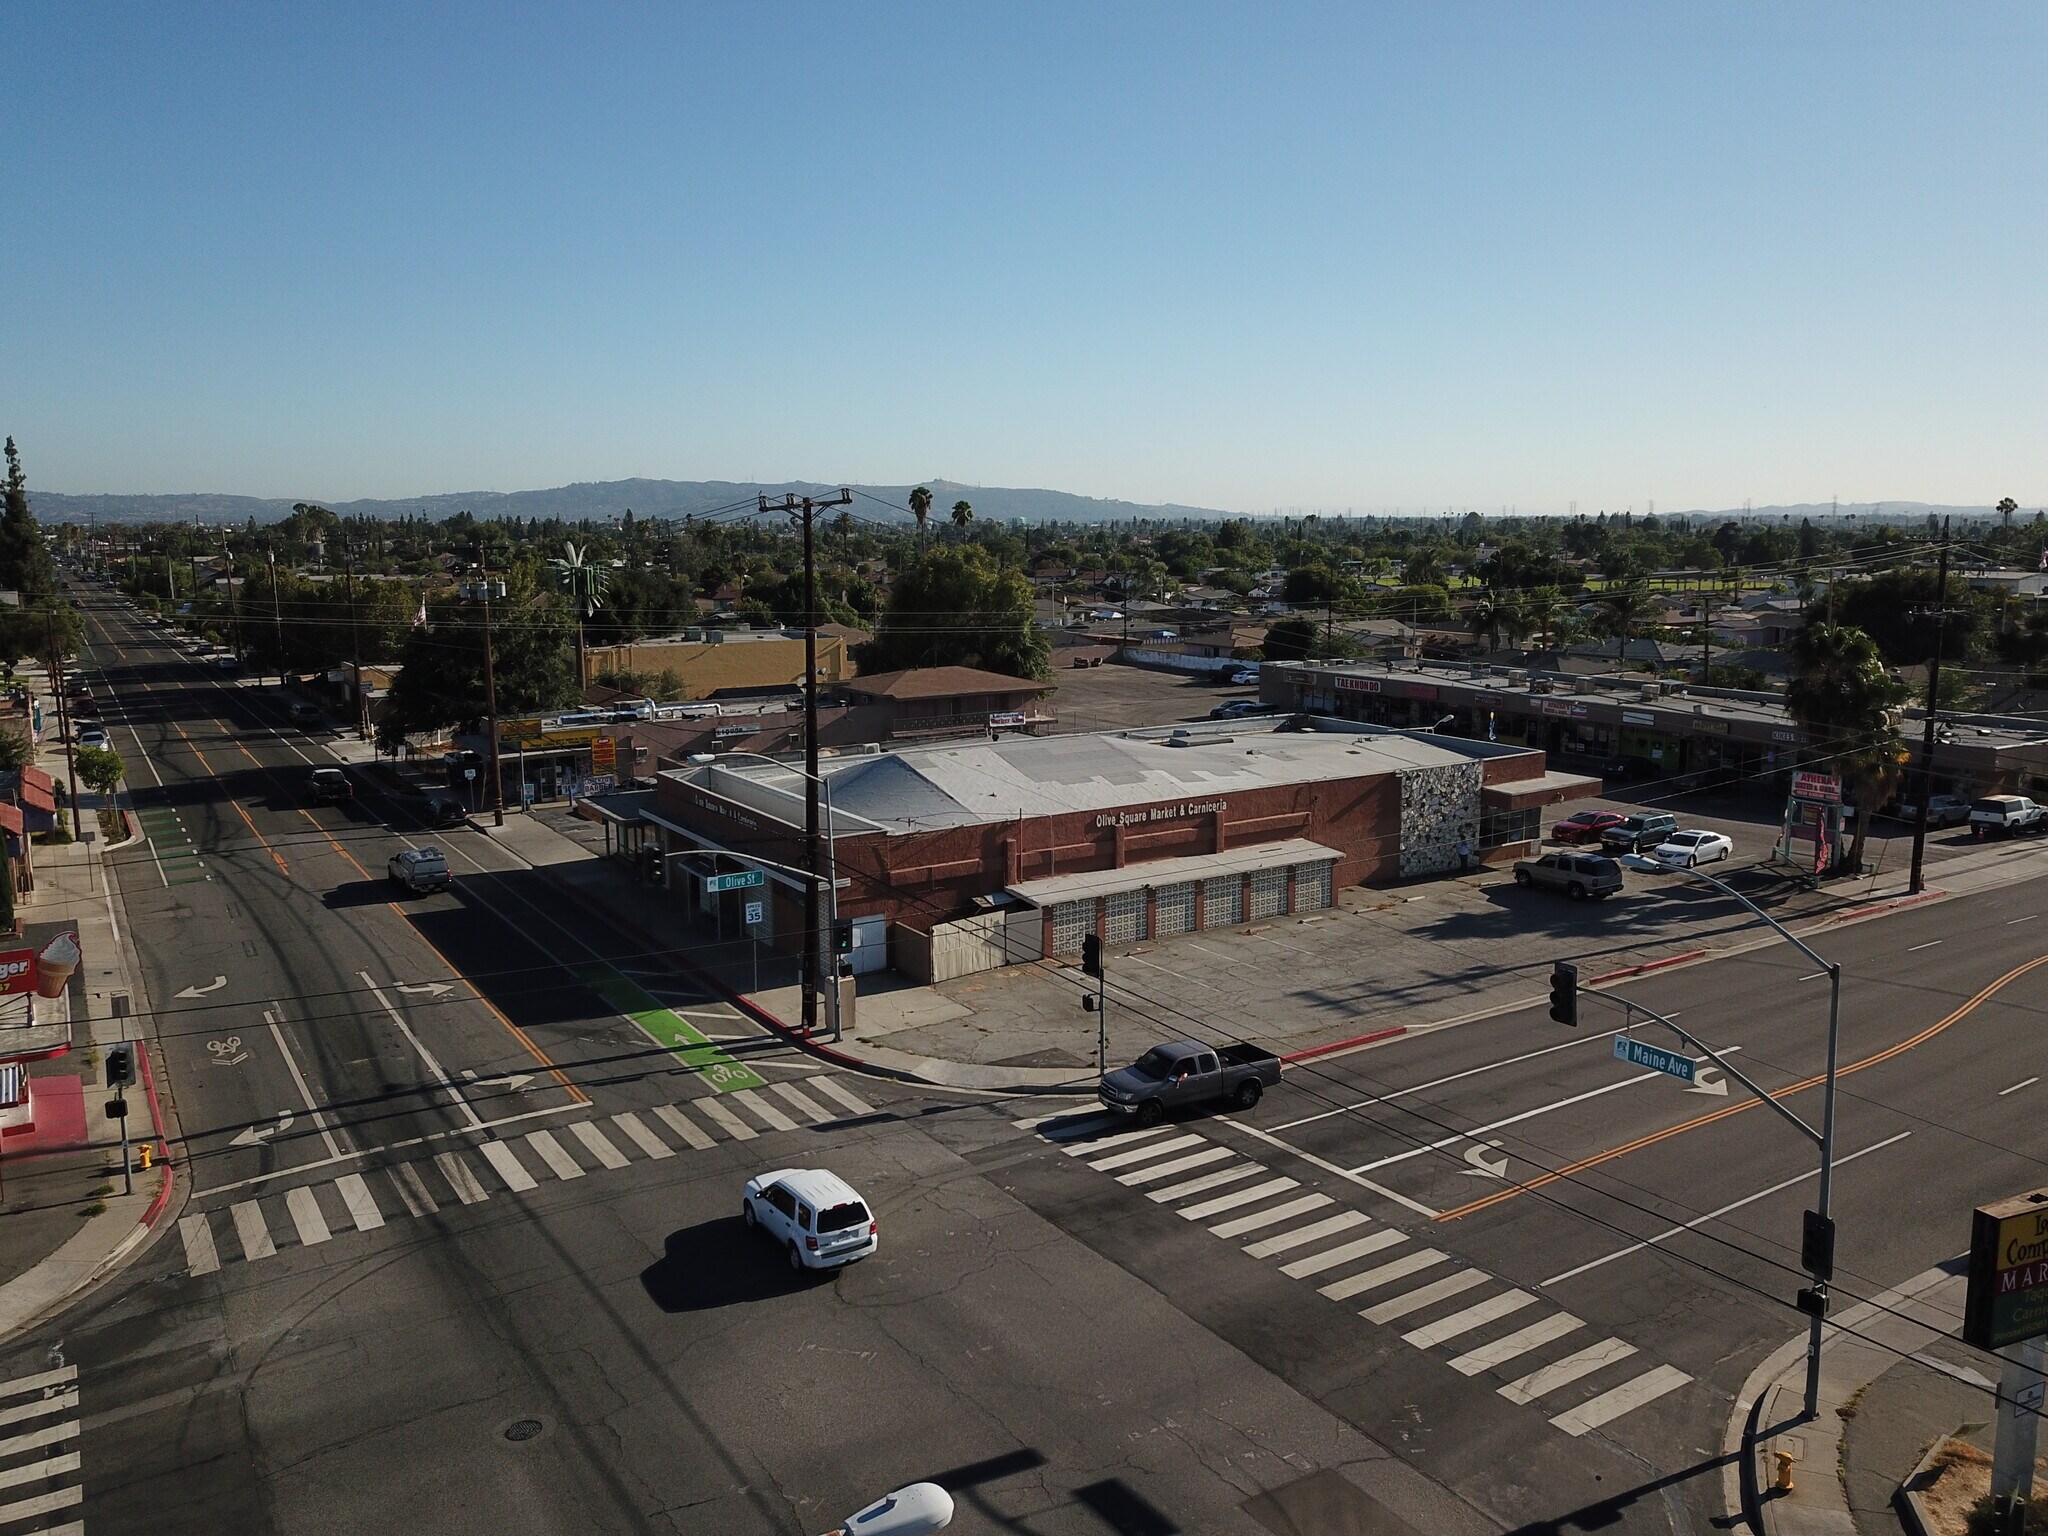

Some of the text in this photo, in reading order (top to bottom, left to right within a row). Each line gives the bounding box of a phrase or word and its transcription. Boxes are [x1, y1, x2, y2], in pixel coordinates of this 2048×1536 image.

[585, 783, 613, 792] BARBER
[1096, 799, 1227, 828] Olive Square Market & Carniceria
[725, 873, 756, 888] Olive St
[748, 912, 761, 922] 35
[1633, 1044, 1688, 1077] Maine Ave
